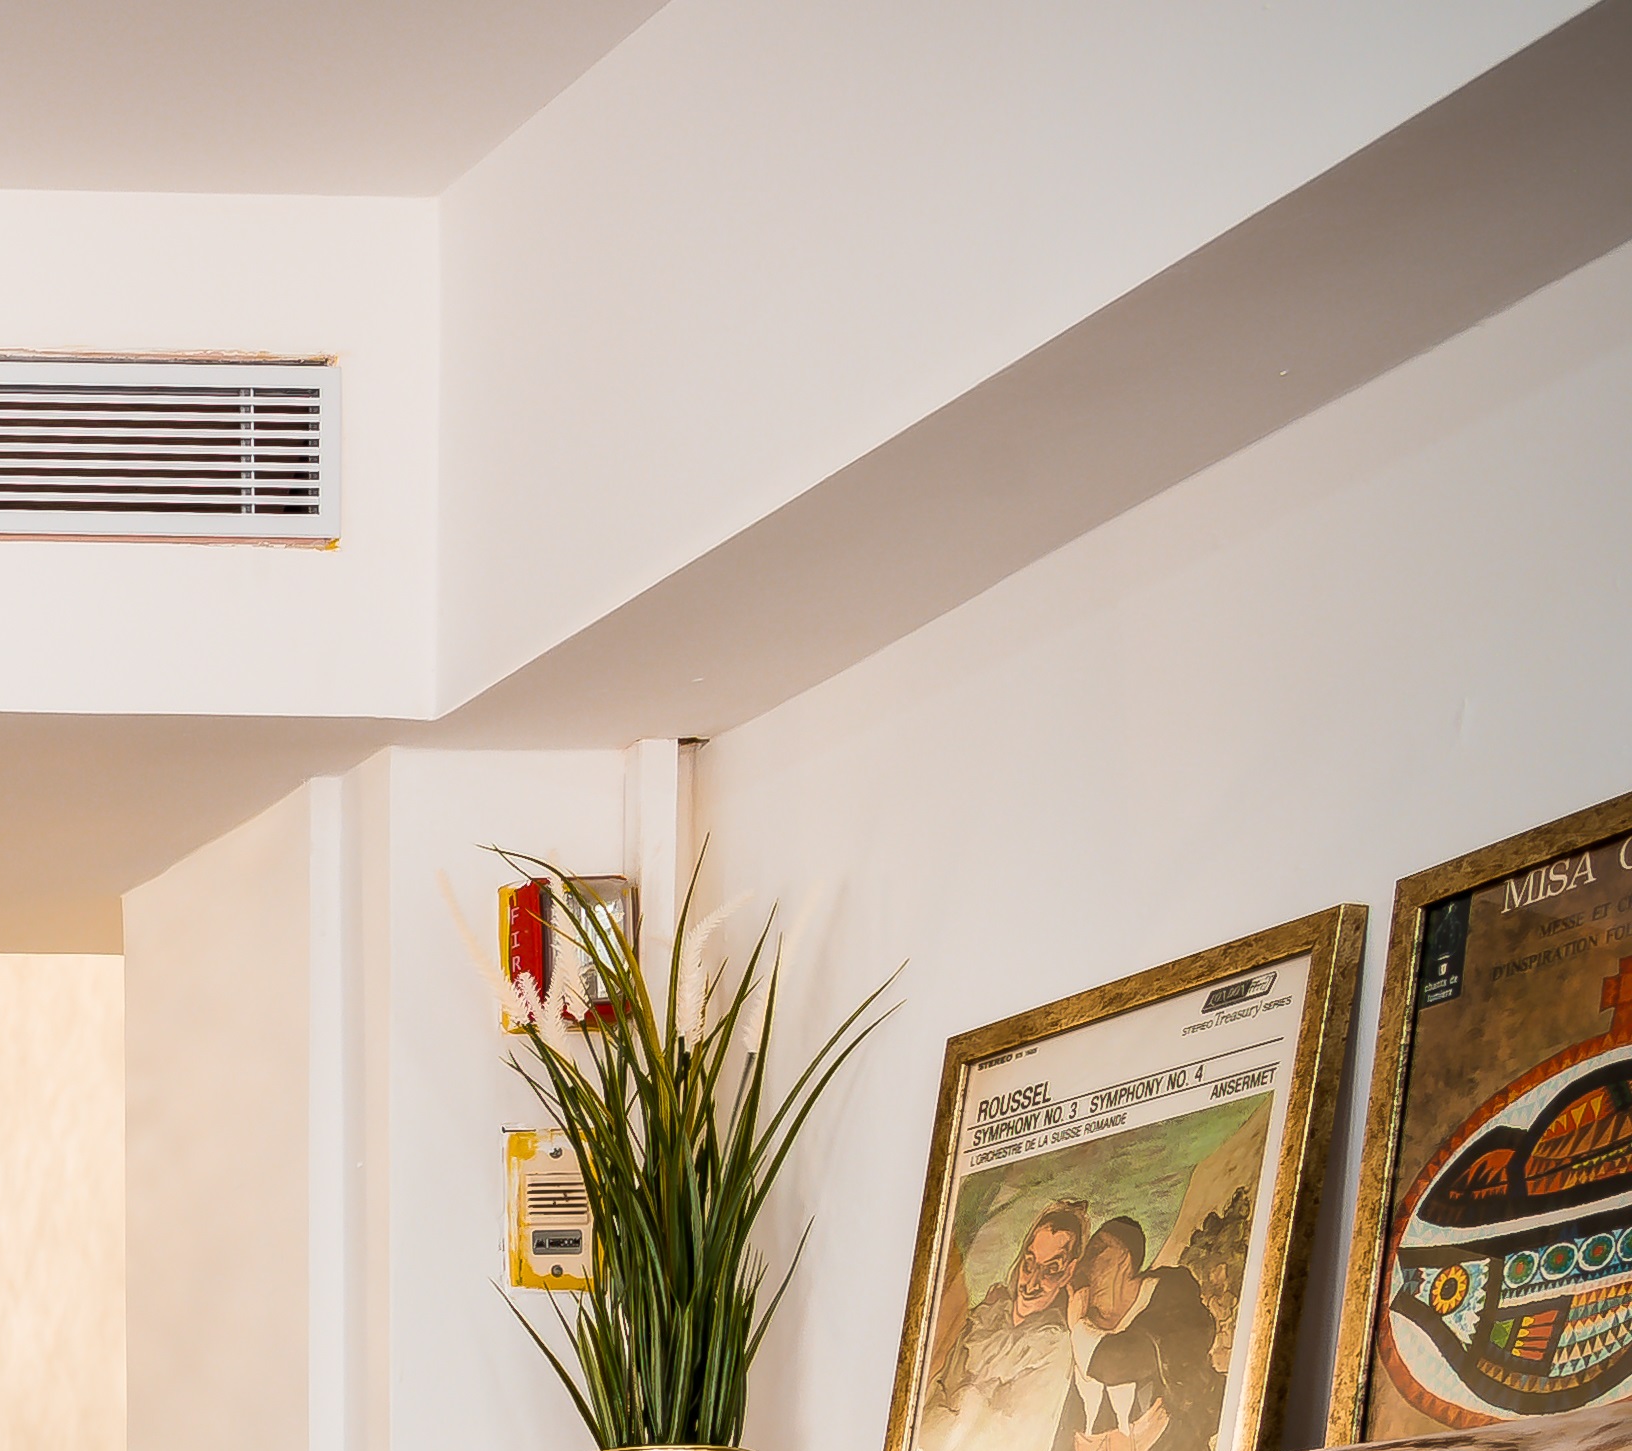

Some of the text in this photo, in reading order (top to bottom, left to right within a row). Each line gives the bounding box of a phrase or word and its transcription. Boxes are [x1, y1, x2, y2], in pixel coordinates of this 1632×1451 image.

[1501, 852, 1597, 914] MISA
[1540, 911, 1586, 938] MESSE
[1591, 902, 1613, 922] ET
[1492, 932, 1600, 981] D'INSPIRATION
[1214, 1000, 1263, 1028] Treasury
[1262, 995, 1292, 1012] SERIES
[978, 1054, 1013, 1071] STEREO
[977, 1081, 1052, 1123] ROUSSEL
[1209, 1069, 1276, 1100] ANSERMET
[973, 1065, 1204, 1147] SYMPHONY NO. 3 SYMPHONY NO. 4
[970, 1113, 1128, 1167] L'ORCHESTRE DE LA SUISSE ROMANDE
